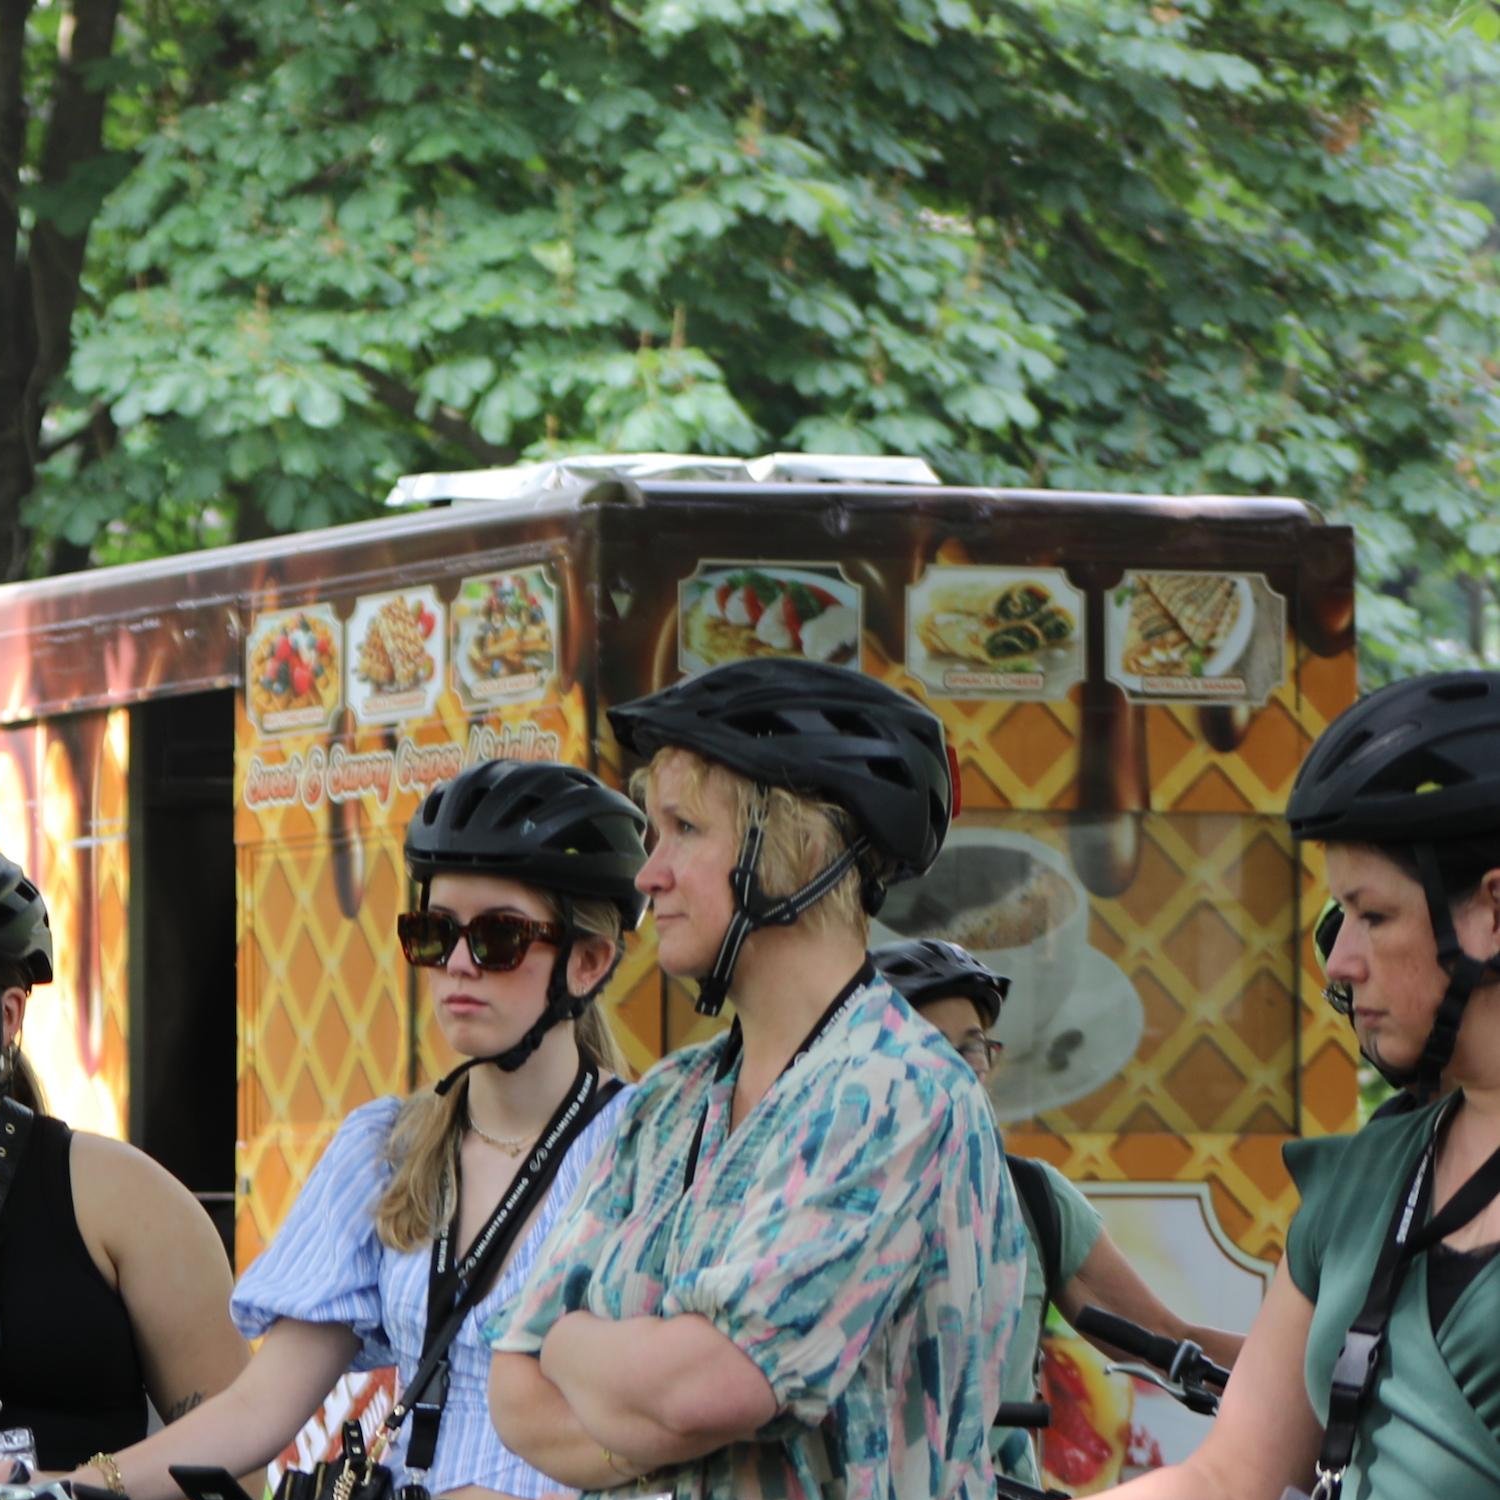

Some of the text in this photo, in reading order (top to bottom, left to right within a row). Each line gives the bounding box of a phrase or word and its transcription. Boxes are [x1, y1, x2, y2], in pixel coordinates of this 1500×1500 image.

[327, 742, 394, 810] Savory
[544, 1101, 580, 1150] UNLIMITED
[473, 1176, 530, 1258] UNLIMITED BIKING
